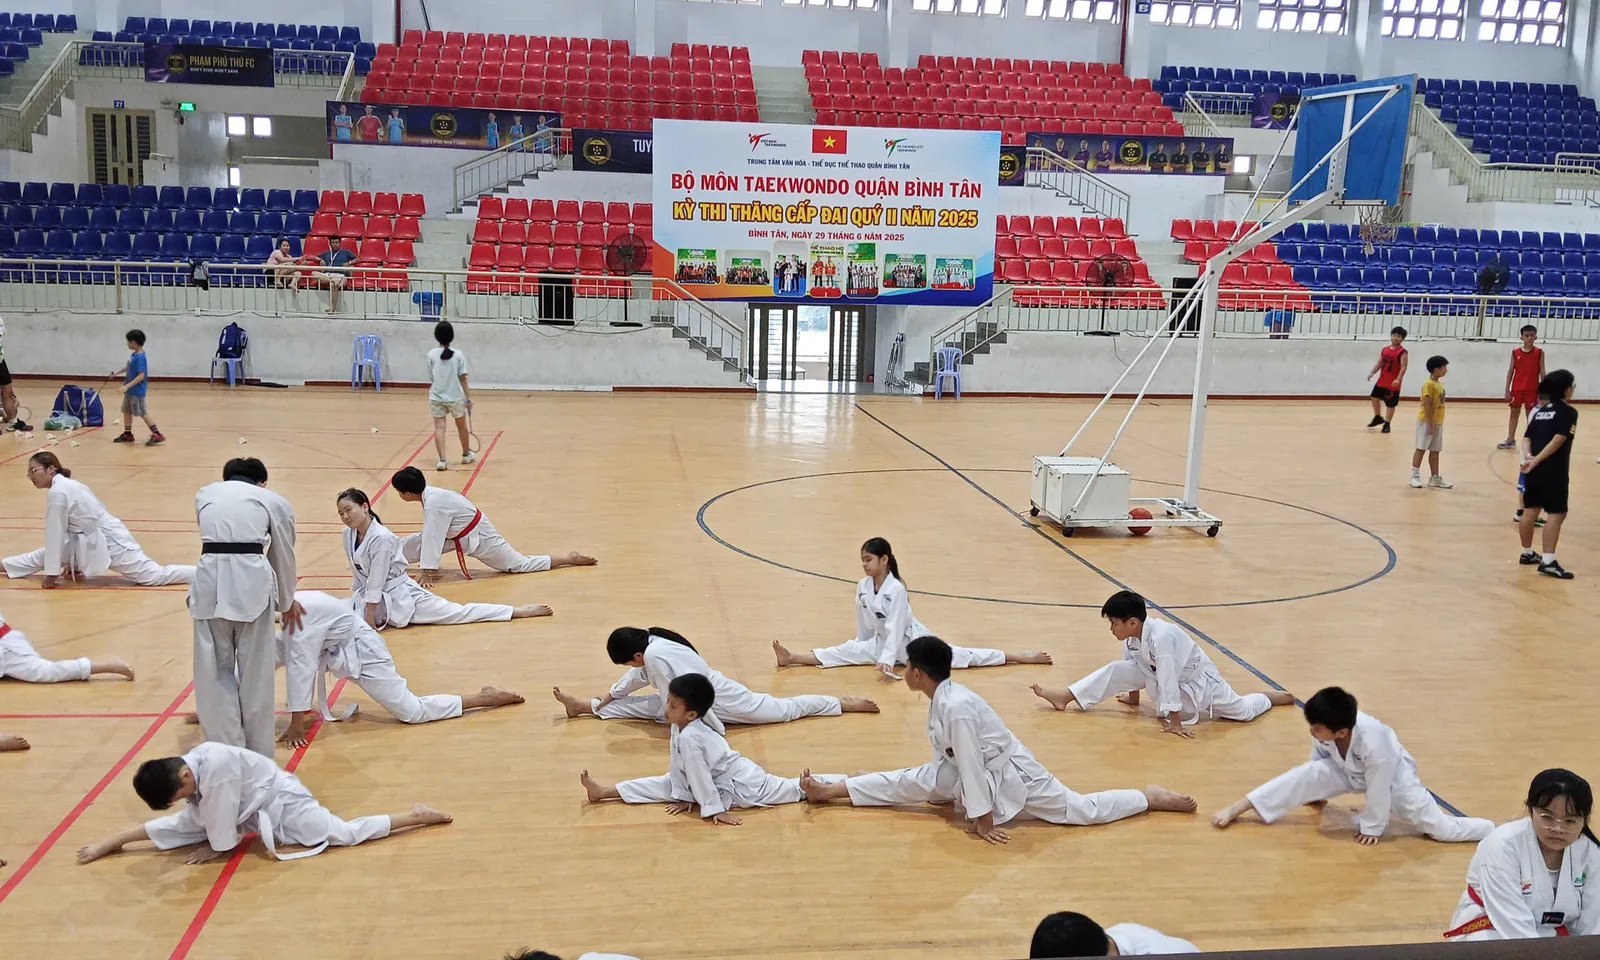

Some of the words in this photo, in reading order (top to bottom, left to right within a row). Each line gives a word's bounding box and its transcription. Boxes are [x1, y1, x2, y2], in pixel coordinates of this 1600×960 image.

[245, 58, 254, 68] FC
[633, 139, 652, 152] TUY
[672, 170, 695, 193] BỘ
[701, 171, 738, 191] MÔN
[744, 176, 849, 194] TAEKWONDO
[855, 176, 899, 199] QUẬN
[905, 177, 944, 197] BÌNH
[950, 178, 982, 198] TÂN
[672, 198, 696, 220] KỲ
[699, 202, 727, 222] THI
[730, 201, 783, 223] THĂNG
[785, 199, 818, 224] CẤP
[820, 206, 848, 225] ĐAI
[851, 203, 883, 228] QUÝ
[886, 208, 897, 226] II
[901, 205, 936, 227] NĂM
[938, 209, 978, 227] 2025
[748, 228, 768, 237] BÌNH
[771, 229, 789, 239] TÂN,
[792, 230, 812, 239] NGÀY
[828, 231, 854, 240] THÁNG
[864, 232, 882, 240] NĂM
